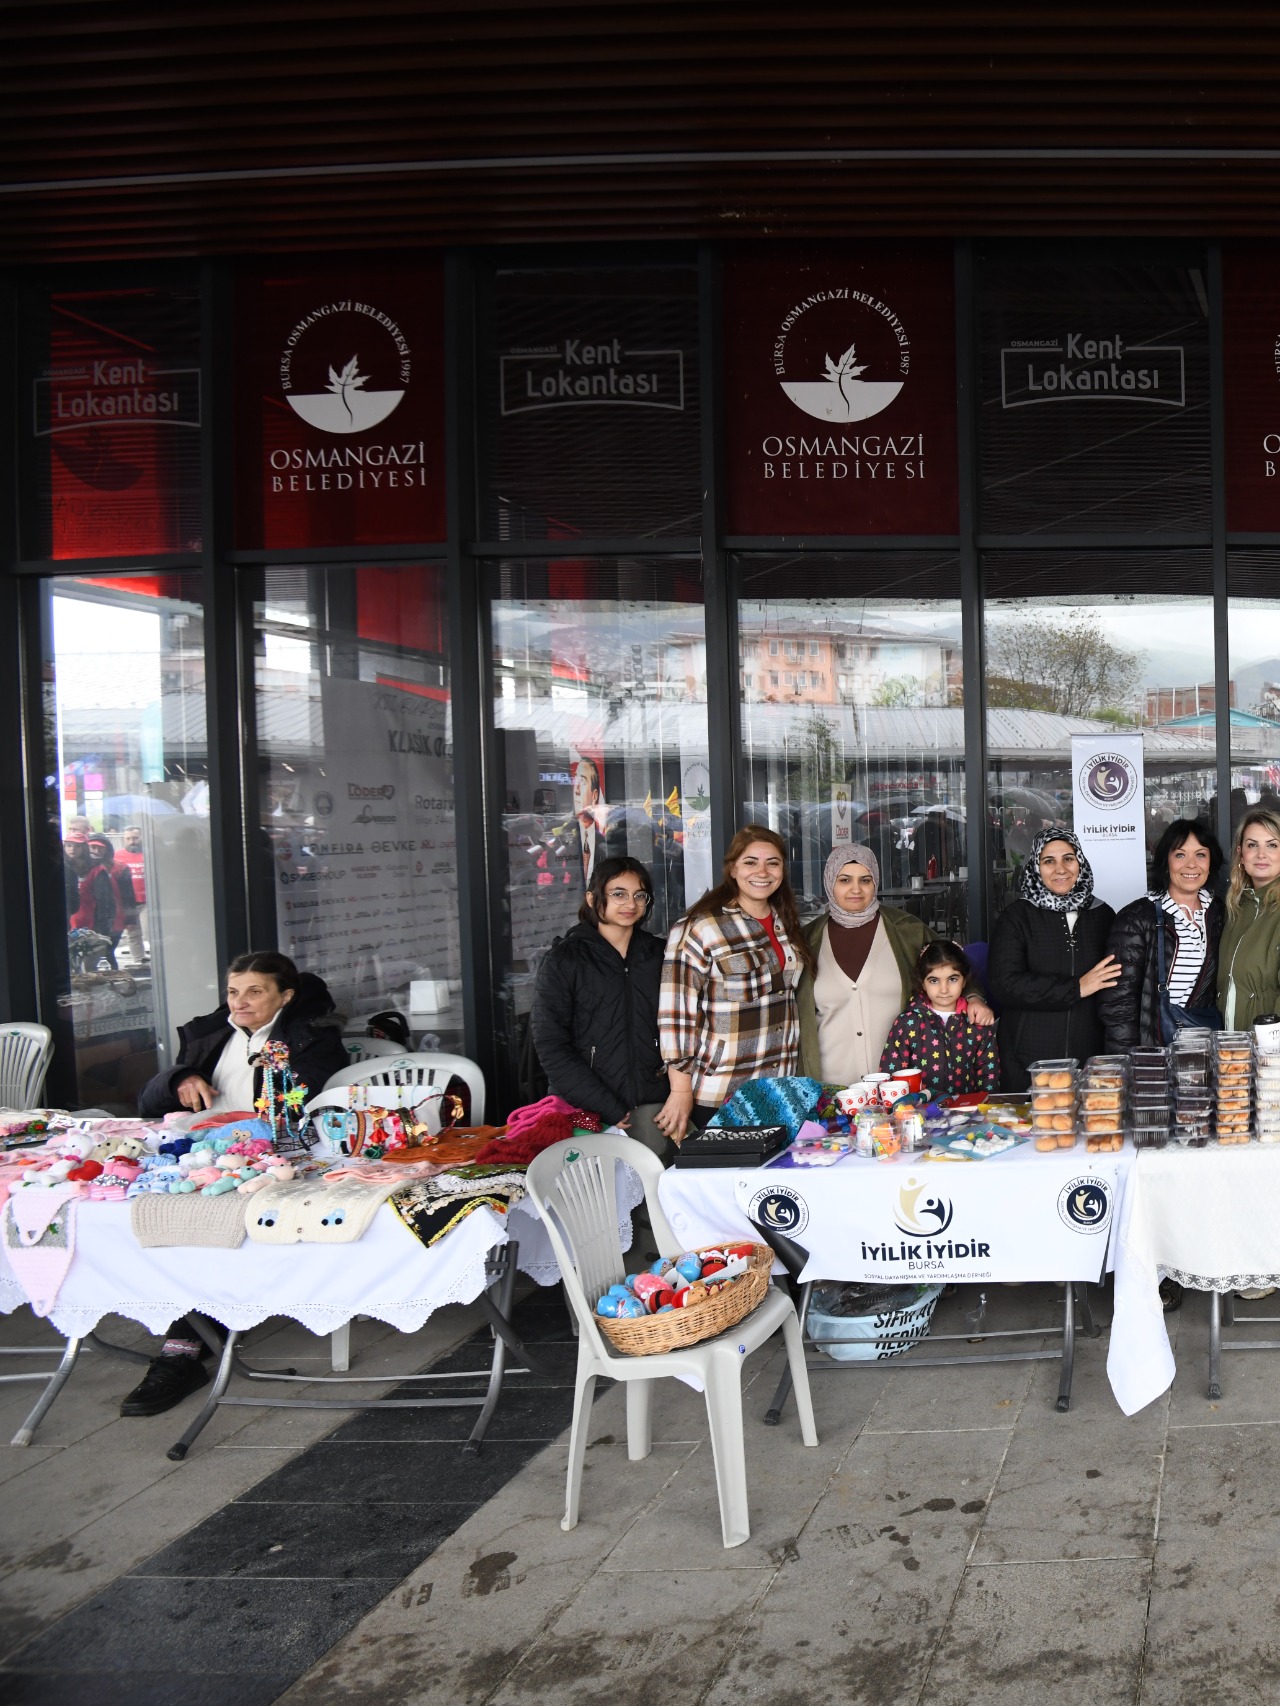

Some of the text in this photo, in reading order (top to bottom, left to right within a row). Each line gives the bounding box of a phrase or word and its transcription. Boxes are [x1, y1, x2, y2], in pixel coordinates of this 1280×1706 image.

[774, 287, 911, 375] BURSA OSMANGAZİ BELEDİYESİ 1987
[1010, 339, 1058, 348] OSMANGAZİ
[280, 300, 412, 389] BURSA OSMANGAZİ BELEDİYESİ 1987
[565, 338, 621, 366] Kent
[1067, 333, 1123, 359] Kent
[93, 358, 145, 386] Kent
[526, 368, 658, 397] Lokantası
[1028, 363, 1159, 390] Lokantası
[57, 387, 179, 417] Lokantası
[270, 441, 425, 470] OSMANGAZİ
[762, 433, 925, 456] OSMANGAZİ
[272, 467, 426, 492] BELEDİYESİ
[763, 460, 925, 479] BELEDİYESİ
[1086, 753, 1130, 770] İYİLİK İYİDİR
[1083, 824, 1136, 833] İYİLİK İYİDİR
[753, 1187, 800, 1202] İYİLİK İYİDİR
[861, 1238, 991, 1261] İYİLİK İYİDİR
[908, 1260, 945, 1270] BURSA
[967, 1271, 992, 1279] DERNEĞİ
